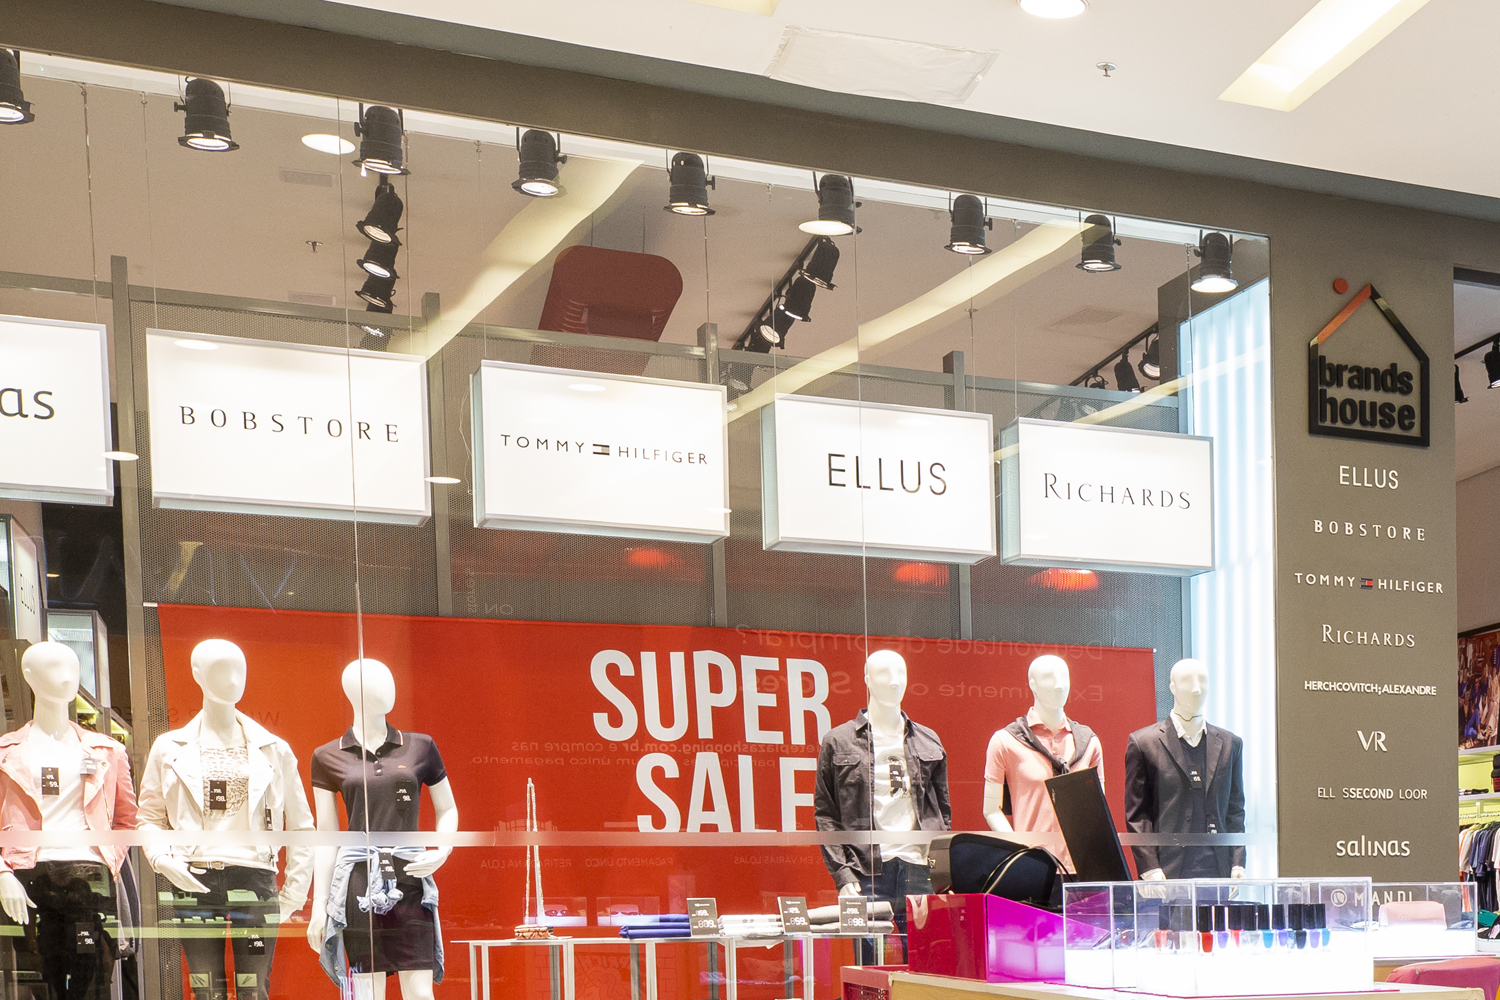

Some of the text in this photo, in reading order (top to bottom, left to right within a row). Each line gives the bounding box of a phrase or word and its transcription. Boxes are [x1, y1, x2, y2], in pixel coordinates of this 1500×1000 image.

[1318, 355, 1414, 395] brands
[179, 405, 400, 443] BOBSTORE
[1319, 389, 1416, 431] house
[500, 433, 708, 466] TOMMY HILFIGER
[828, 453, 948, 496] ELLUS
[1339, 465, 1399, 490] ELLUS
[1313, 519, 1426, 541] BOBSTORE
[1294, 572, 1444, 594] TOMMY HILFIGER
[589, 649, 832, 746] SUPER
[1303, 680, 1437, 697] HERCHCOVITCH;ALEXANDRE
[1356, 730, 1388, 752] VR
[636, 751, 818, 833] SALE
[1336, 835, 1411, 857] salinas
